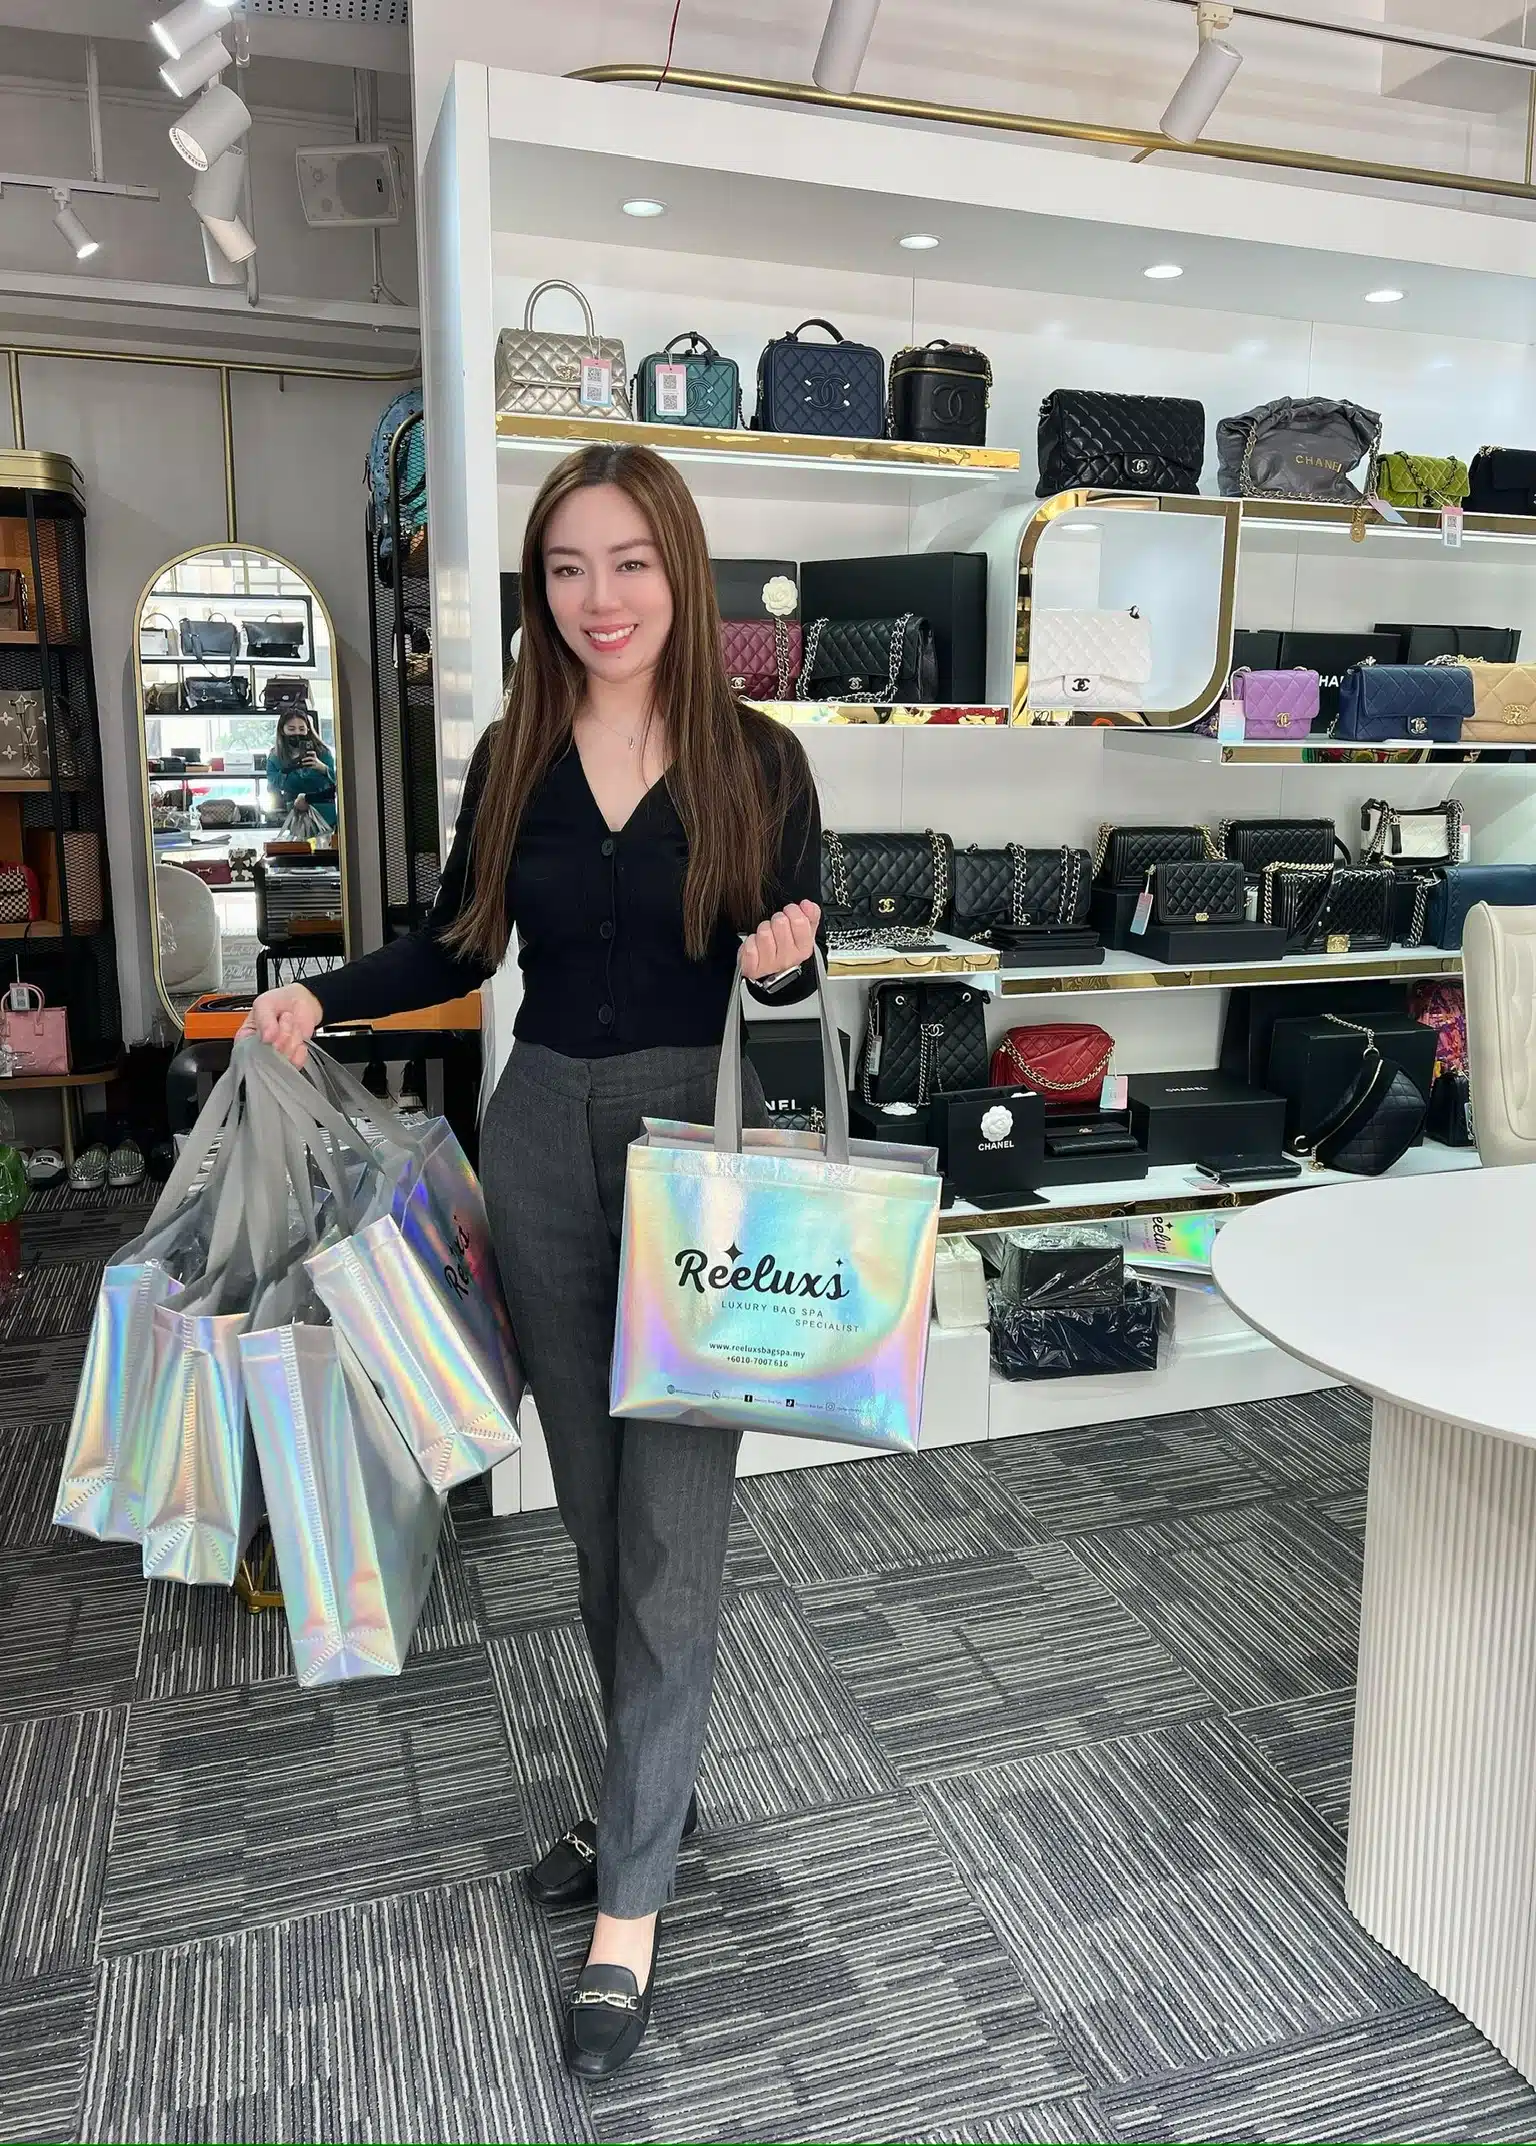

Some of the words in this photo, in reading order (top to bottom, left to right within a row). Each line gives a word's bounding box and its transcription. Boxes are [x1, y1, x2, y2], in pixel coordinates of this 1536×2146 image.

[978, 1140, 1014, 1151] CHANEL
[674, 1248, 850, 1300] Reeluxs
[721, 1301, 767, 1312] LUXURY
[773, 1306, 796, 1315] BAG
[801, 1308, 823, 1318] SPA
[795, 1319, 859, 1333] SPECIALIST
[709, 1342, 806, 1358] www.reeluxsbagspa.my
